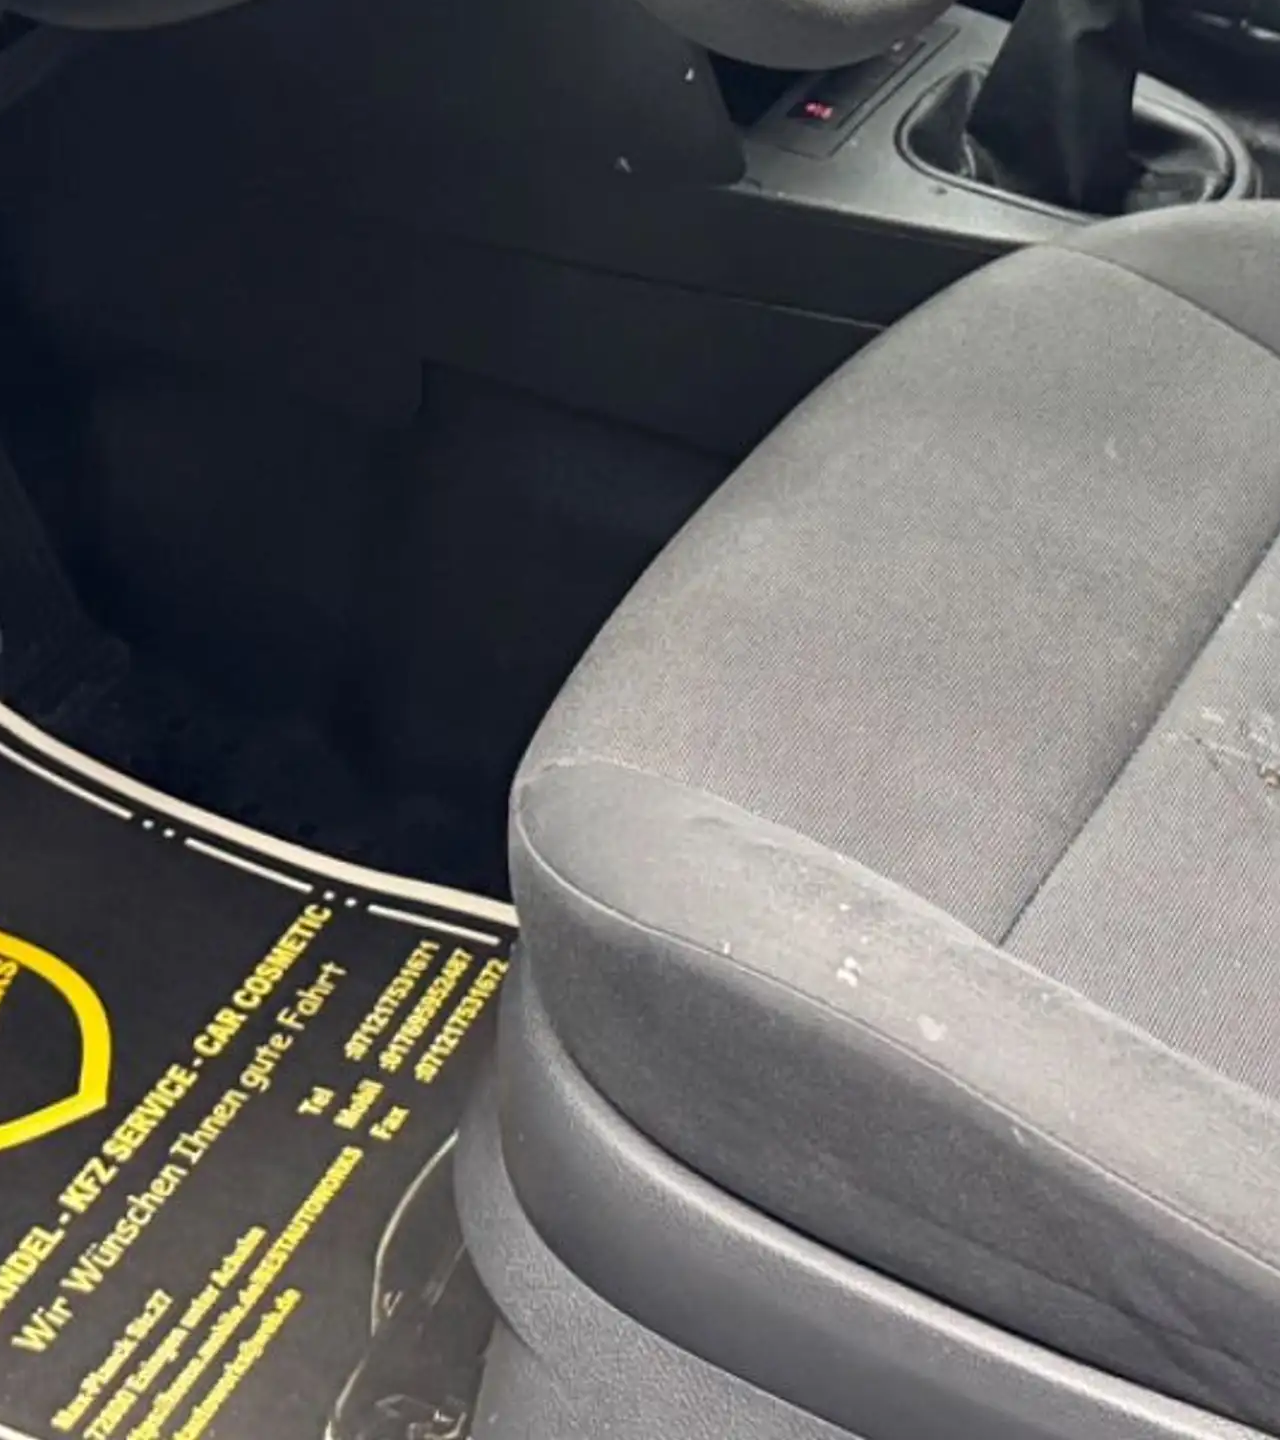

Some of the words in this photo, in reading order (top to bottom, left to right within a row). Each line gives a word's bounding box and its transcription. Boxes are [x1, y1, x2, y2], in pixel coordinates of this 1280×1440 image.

[58, 1156, 119, 1213] KFZ
[102, 1063, 199, 1162] SERVICE
[193, 1007, 248, 1056] CAR
[232, 904, 332, 1009] COSMETIC
[296, 1085, 336, 1115] Tel
[369, 1105, 410, 1141] Fax
[11, 1296, 73, 1352] Wir
[59, 1163, 188, 1293] Wünschen
[169, 1088, 250, 1165] Ihnen
[239, 1032, 295, 1094] gute
[276, 961, 348, 1030] Fahrt
